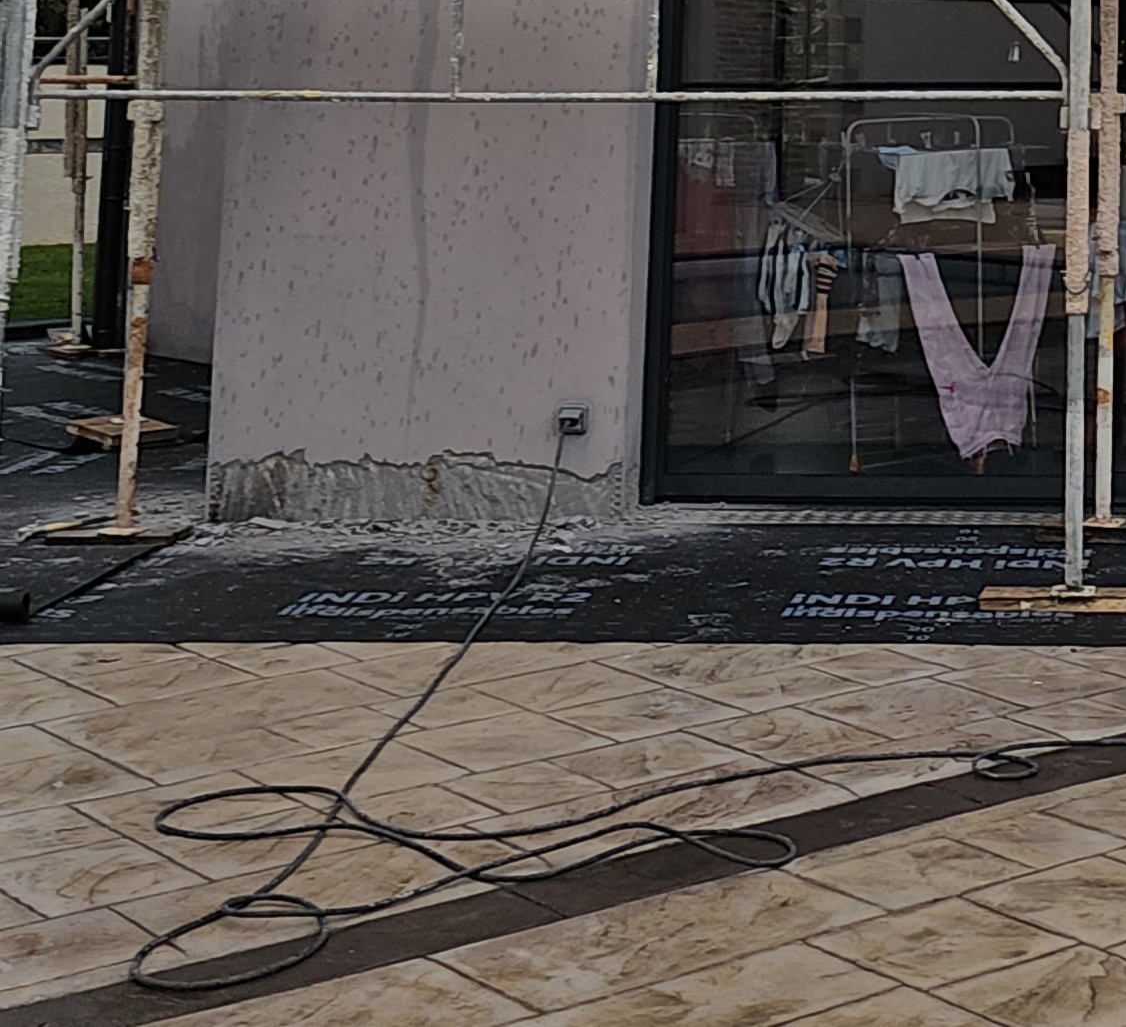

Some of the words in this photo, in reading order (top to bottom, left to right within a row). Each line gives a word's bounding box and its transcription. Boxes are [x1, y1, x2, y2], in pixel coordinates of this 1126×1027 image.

[828, 546, 1095, 557] idispensables
[818, 557, 878, 567] R2
[884, 558, 983, 569] HPV
[413, 592, 519, 603] HPV
[527, 591, 593, 604] R2
